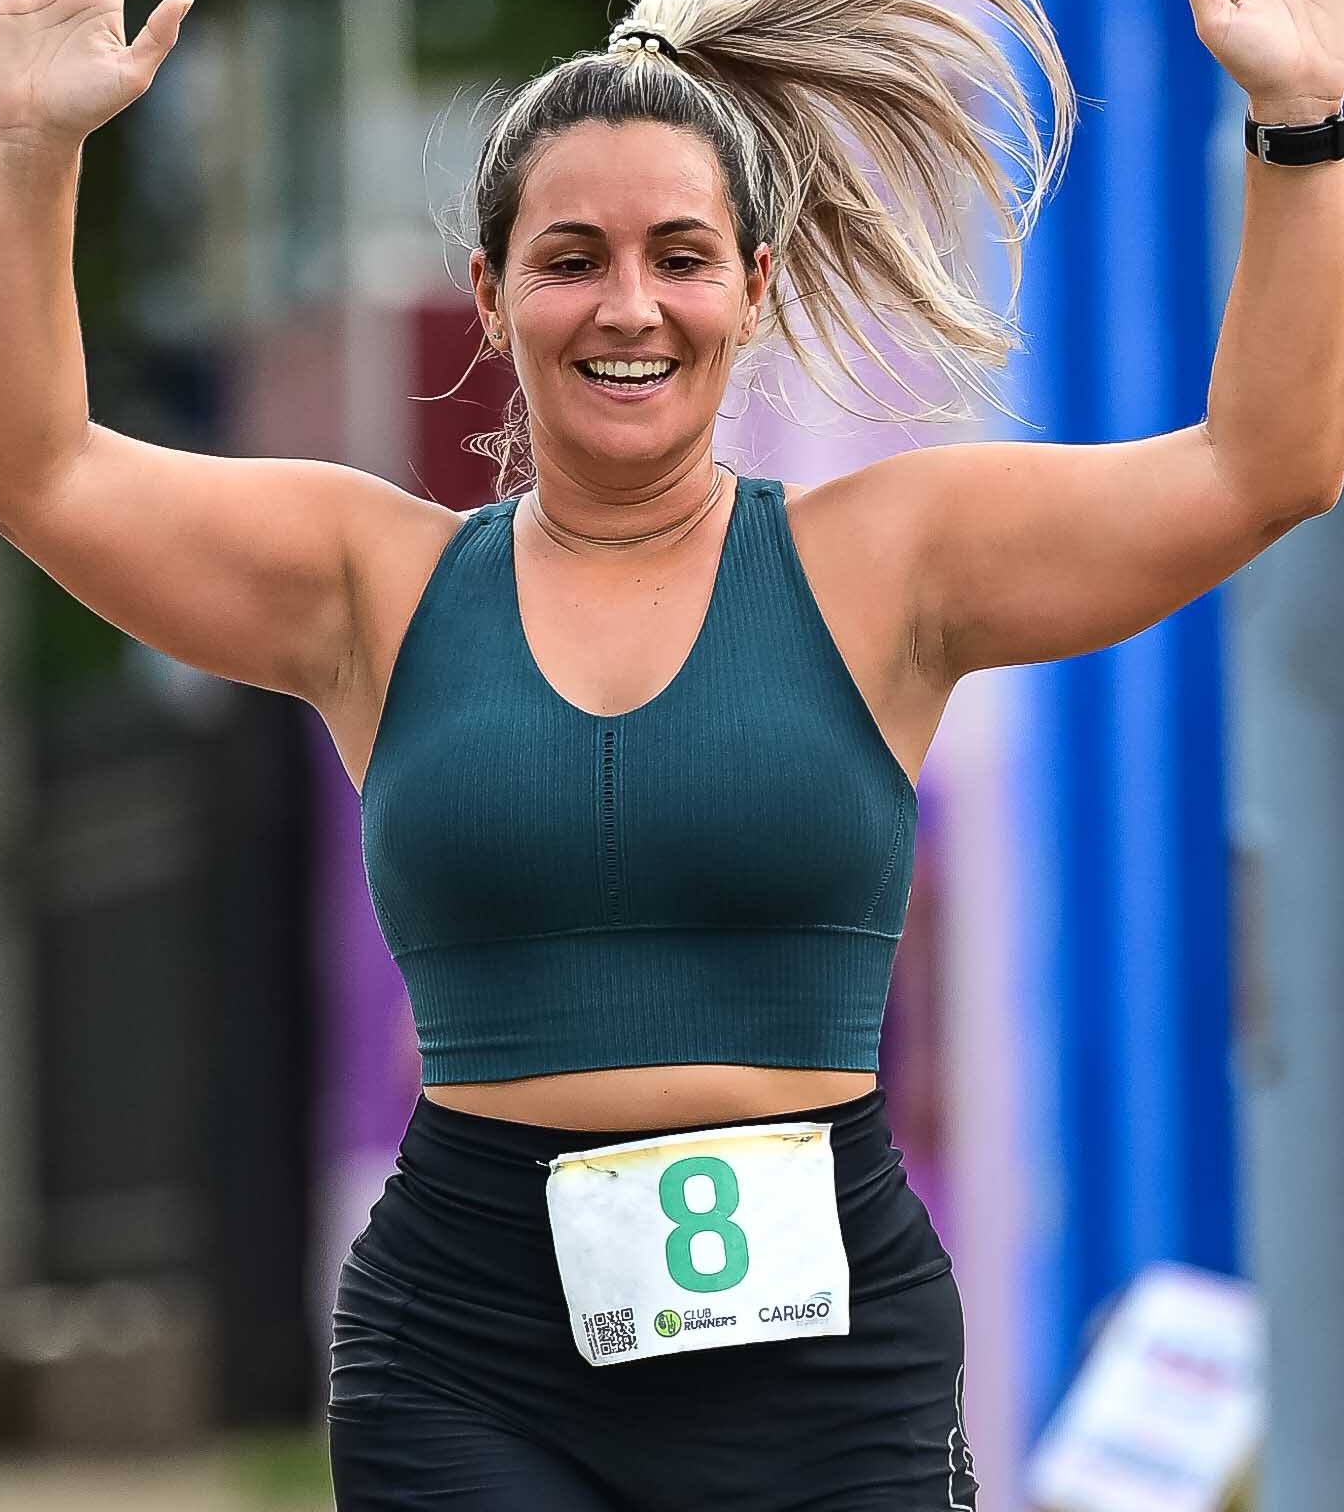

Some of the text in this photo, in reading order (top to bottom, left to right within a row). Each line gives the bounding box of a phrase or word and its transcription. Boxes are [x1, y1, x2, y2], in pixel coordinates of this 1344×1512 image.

[659, 1157, 749, 1293] 8
[684, 1308, 711, 1320] CLUB
[758, 1303, 830, 1322] CARUSO
